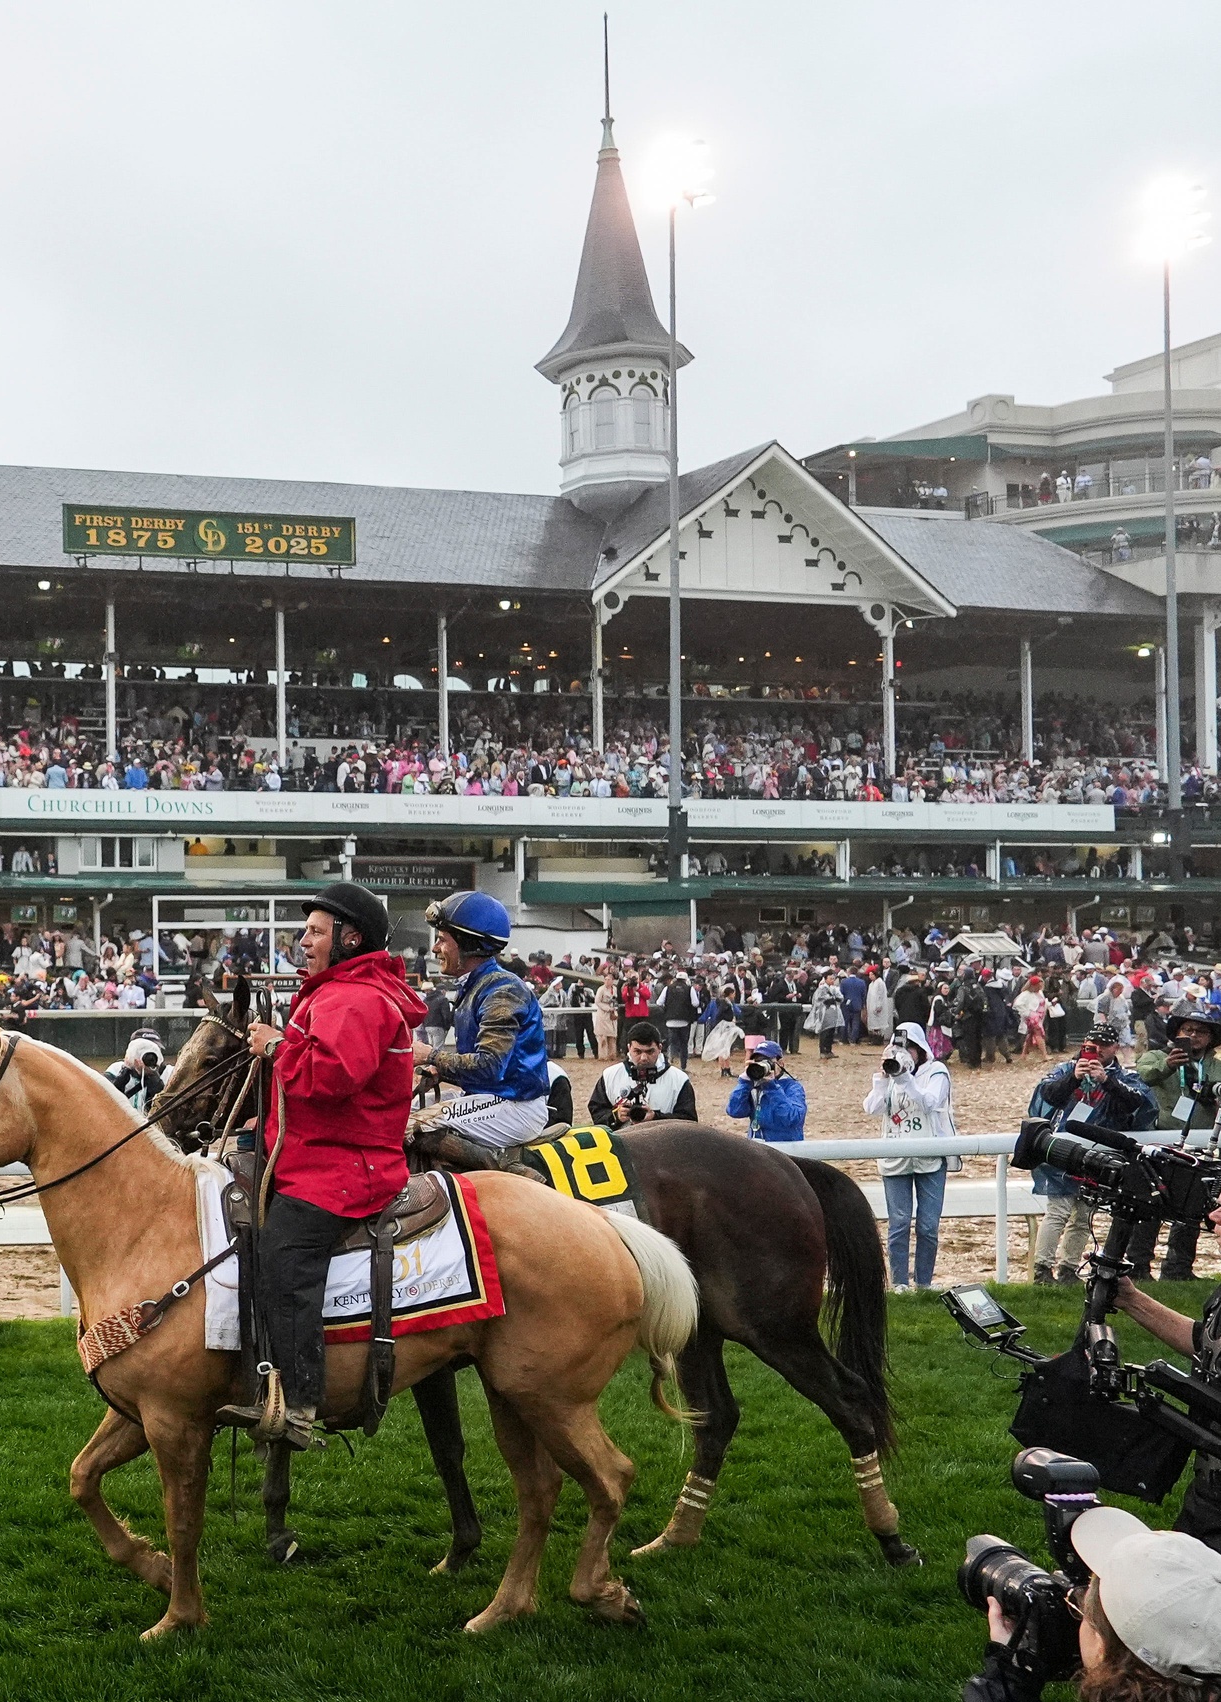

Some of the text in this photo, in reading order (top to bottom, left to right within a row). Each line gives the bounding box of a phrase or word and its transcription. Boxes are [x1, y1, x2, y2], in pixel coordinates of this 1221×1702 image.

[74, 514, 186, 531] FIRST DERBY
[85, 528, 176, 549] 1875
[281, 524, 342, 538] DERBY
[244, 536, 328, 556] 2025
[28, 794, 214, 815] CHURCHILL DOWNS
[331, 802, 370, 810] LONGINES
[477, 804, 514, 812] LONGINES
[617, 806, 653, 814] LONGINES
[368, 864, 435, 875] KENTUCKY DERBY
[409, 877, 458, 886] RESERVE
[473, 1114, 496, 1123] CREAM
[903, 1116, 922, 1133] 38
[527, 1126, 628, 1200] 18
[423, 1273, 462, 1294] DERBY
